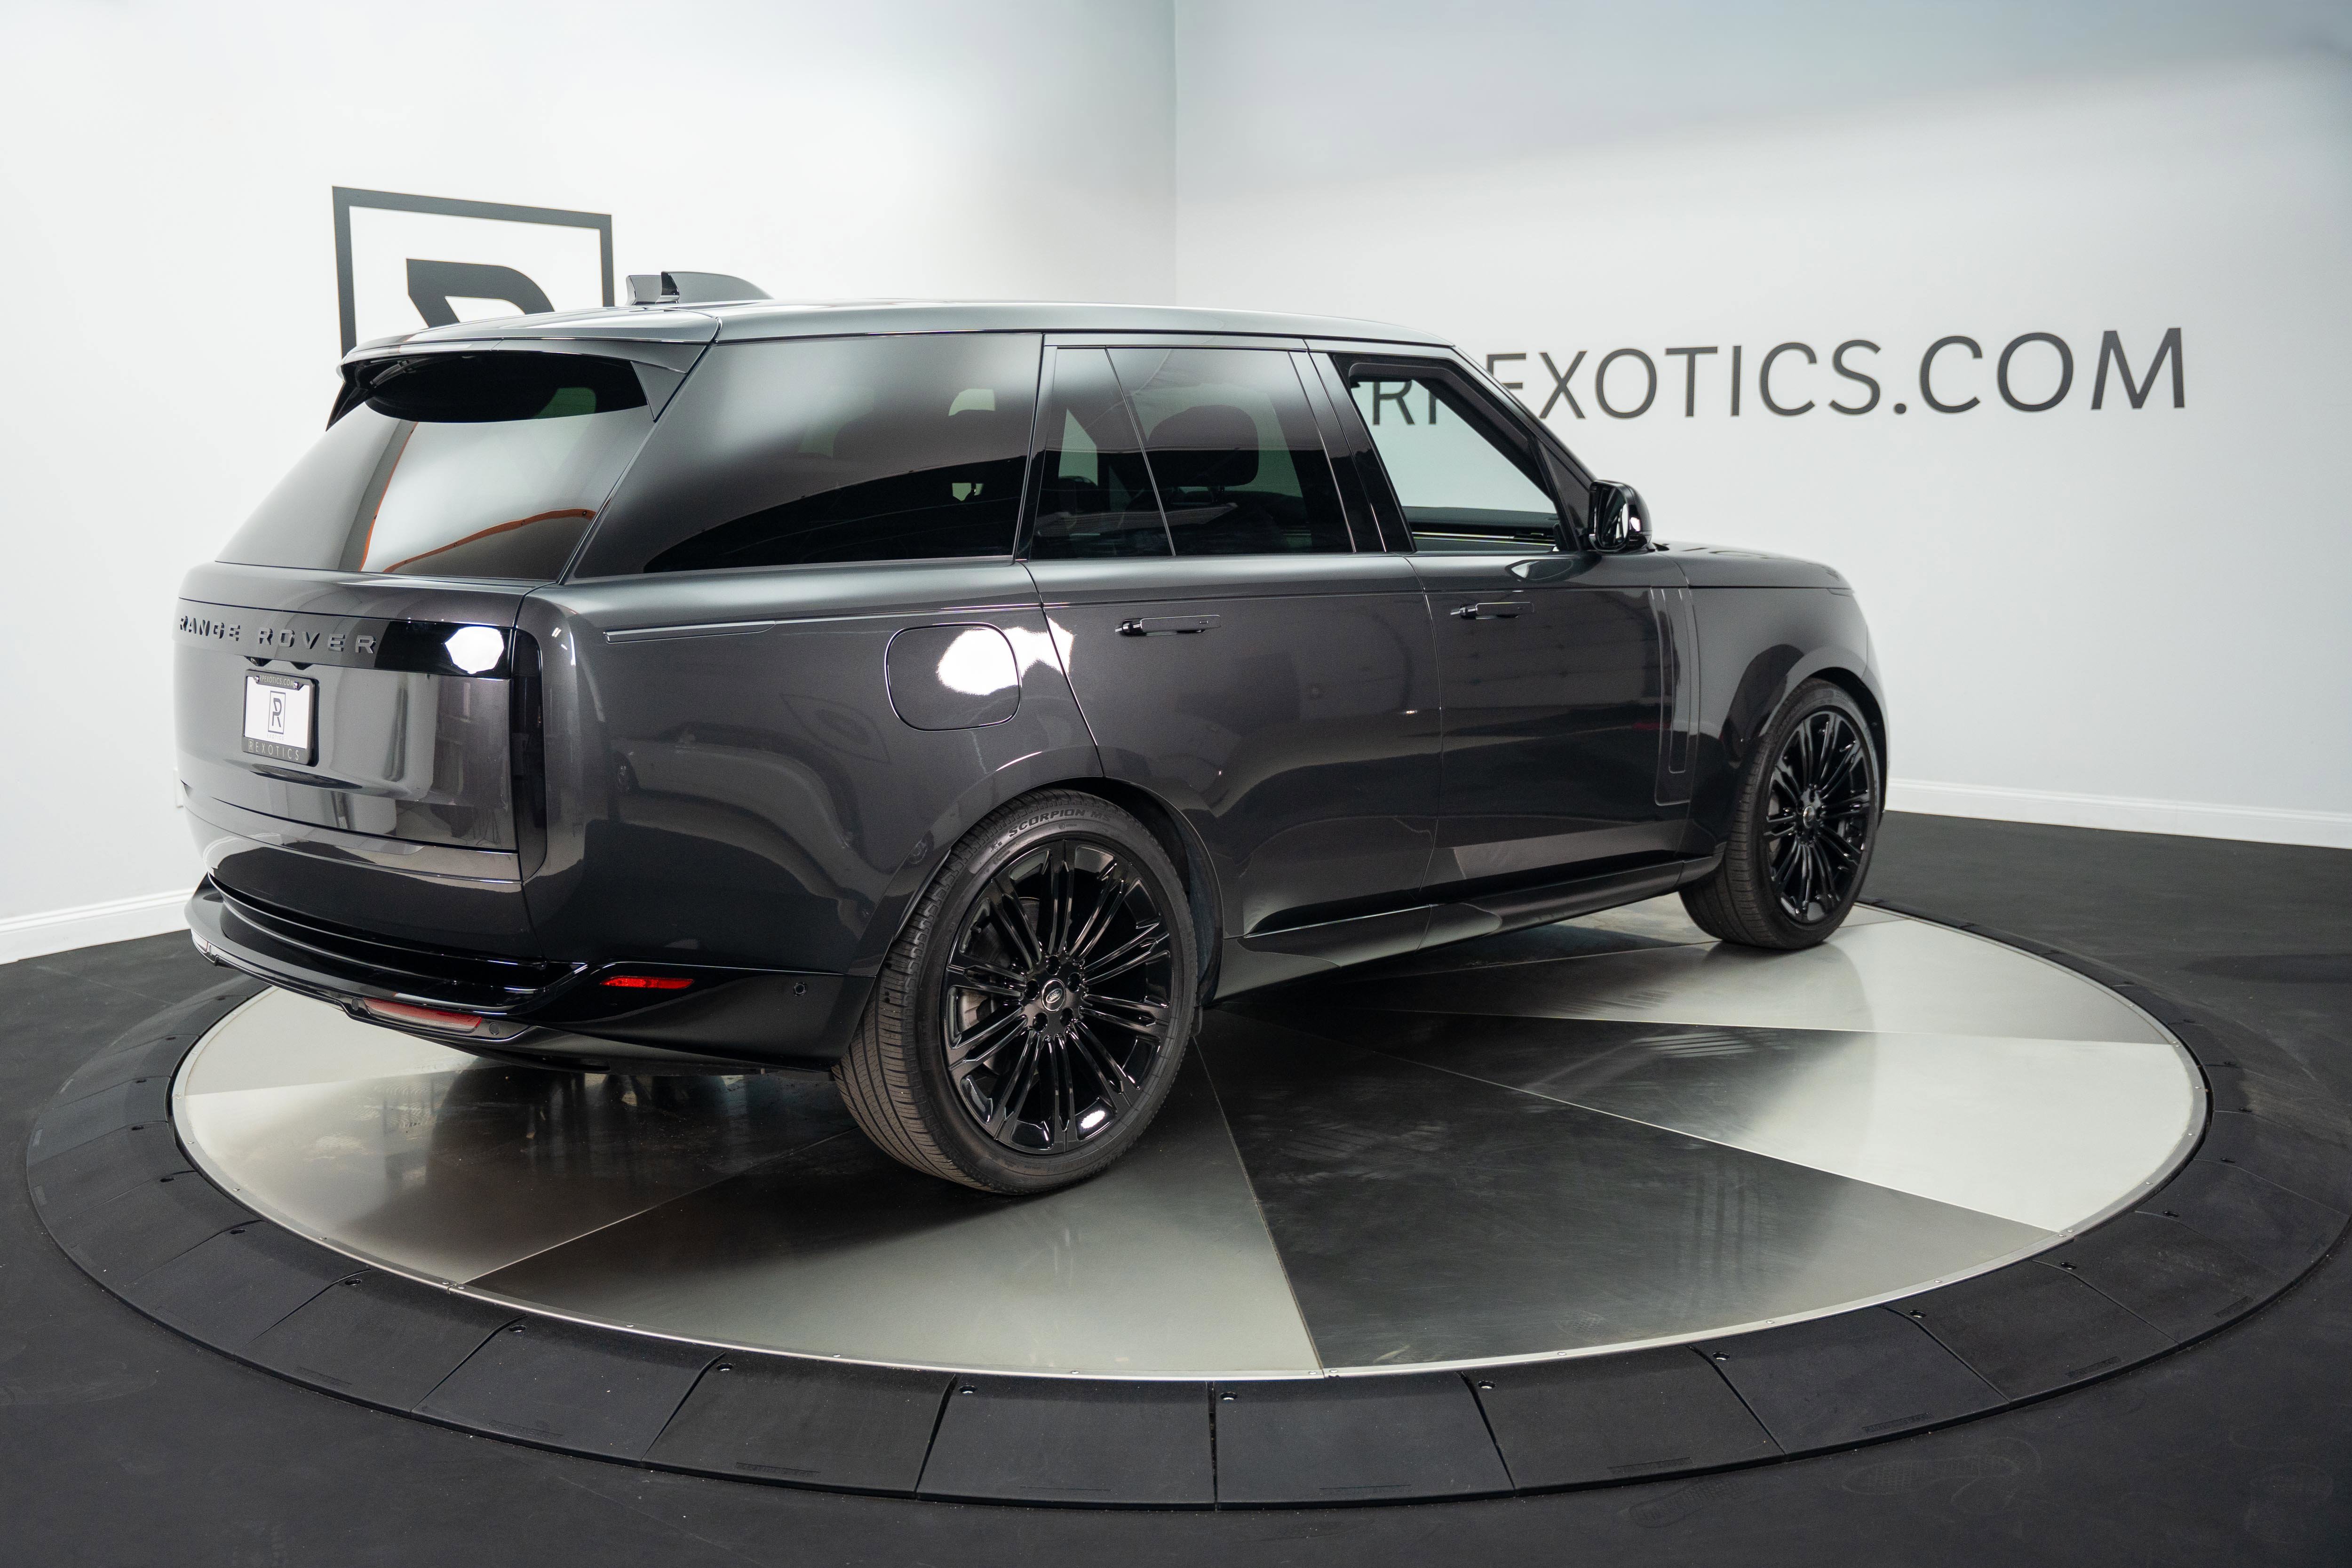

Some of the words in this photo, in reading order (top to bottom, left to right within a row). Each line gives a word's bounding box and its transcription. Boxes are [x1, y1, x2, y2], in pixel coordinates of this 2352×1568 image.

[179, 615, 241, 642] RANGE
[258, 627, 376, 654] ROVER
[255, 742, 299, 761] EXOTICS
[1009, 808, 1086, 837] SCORPION
